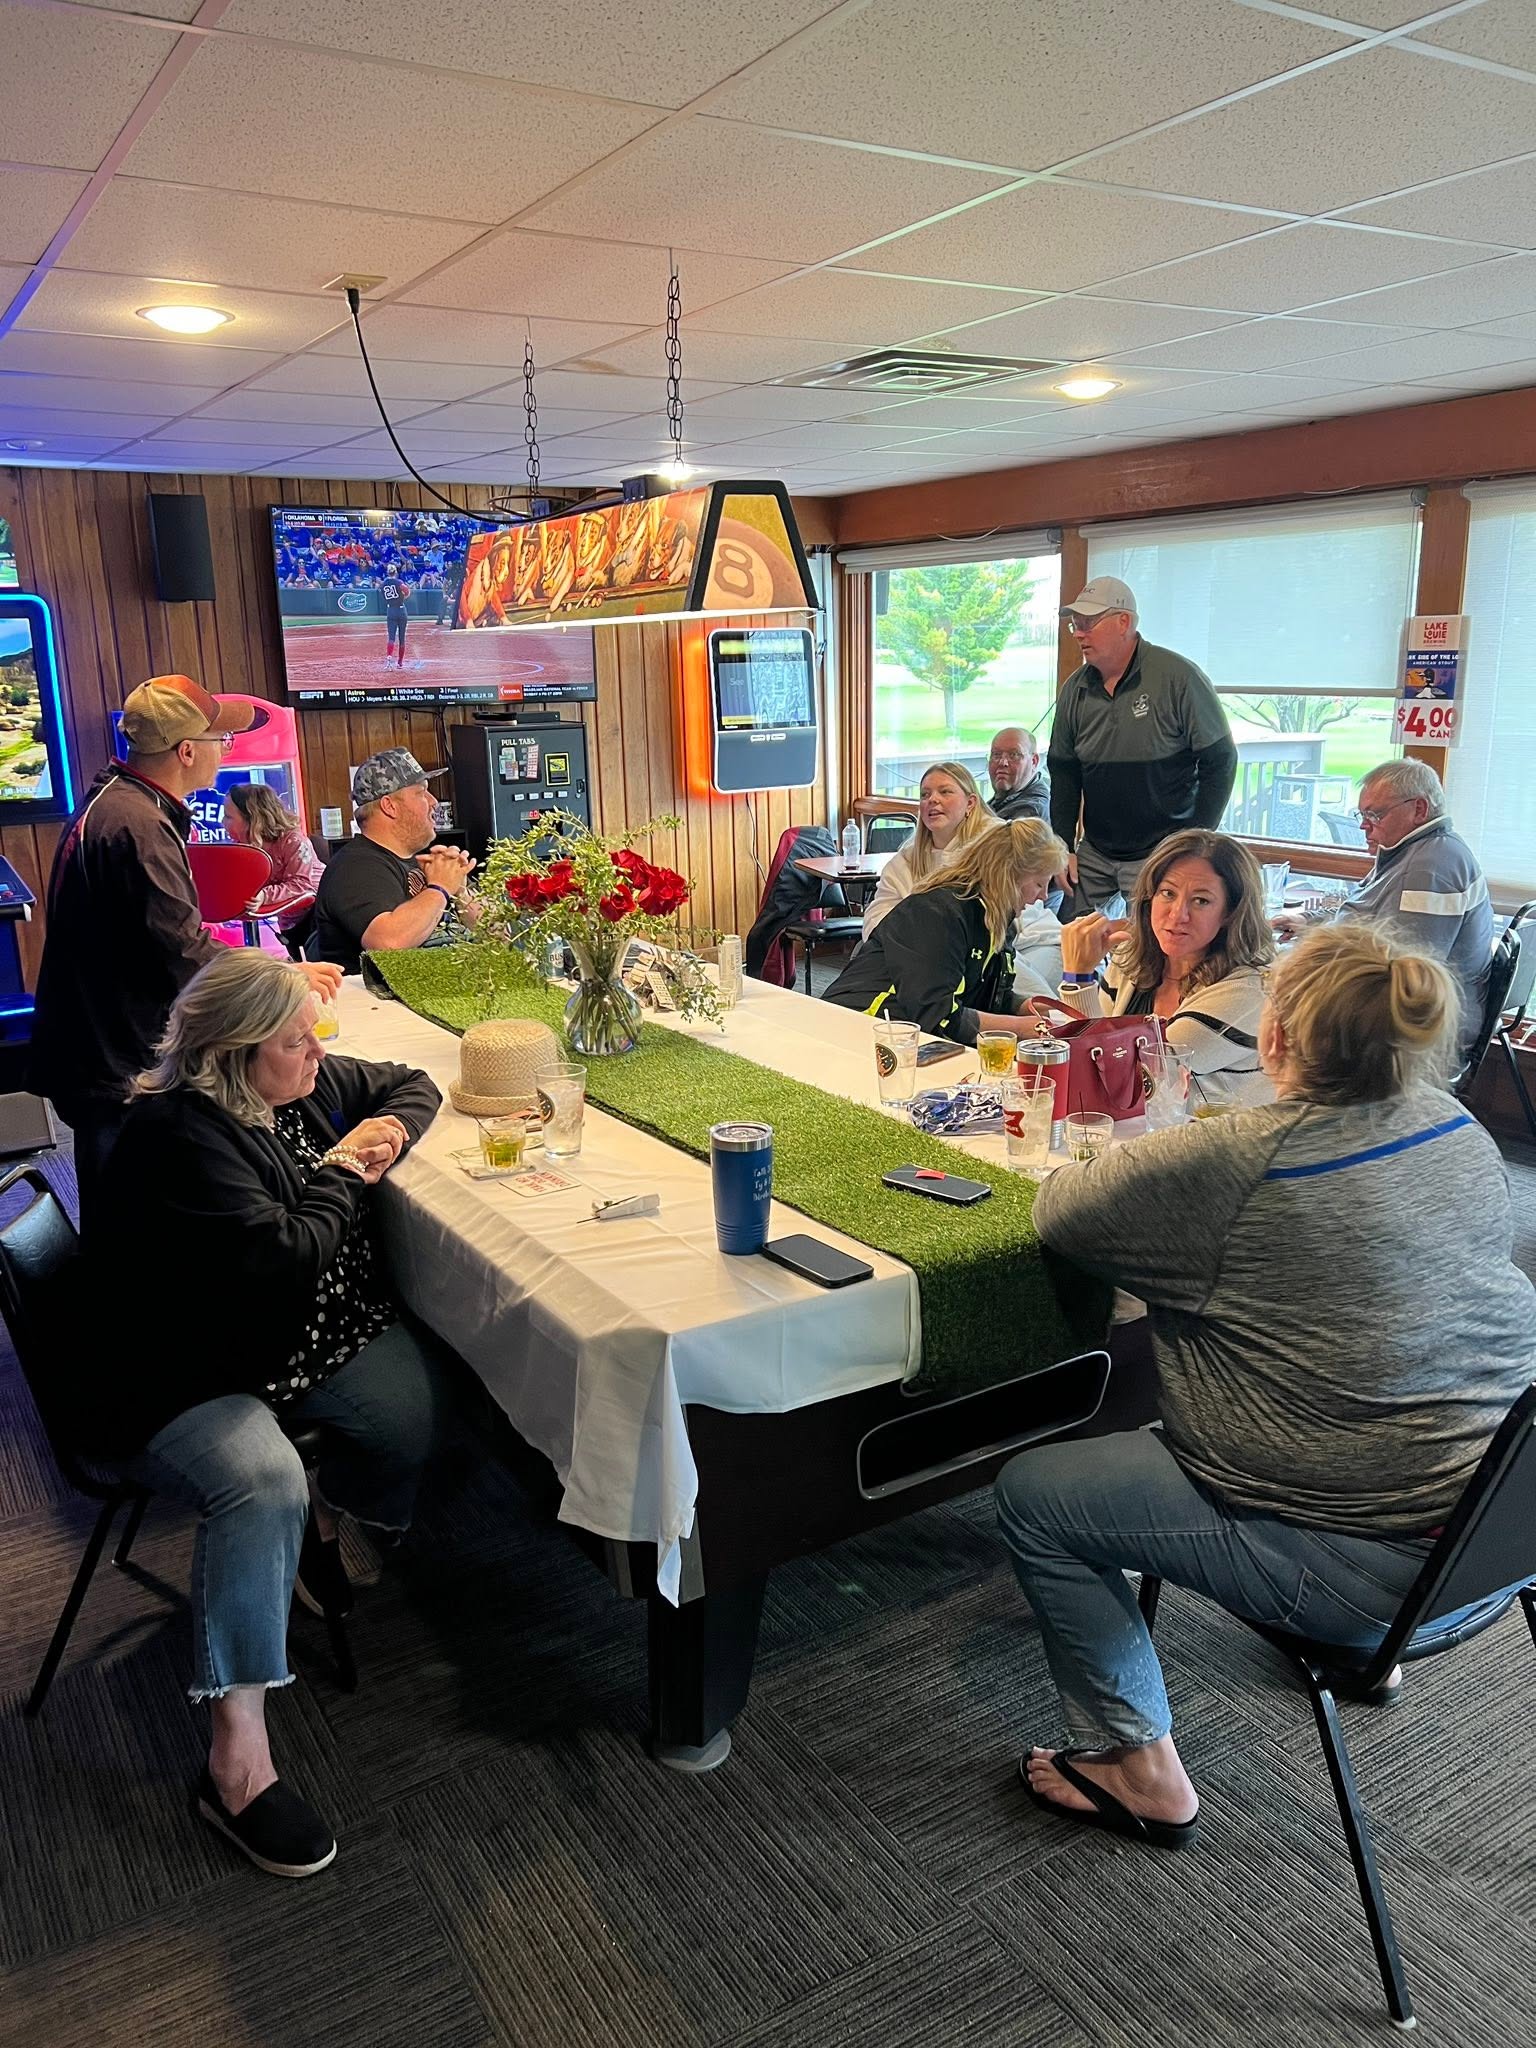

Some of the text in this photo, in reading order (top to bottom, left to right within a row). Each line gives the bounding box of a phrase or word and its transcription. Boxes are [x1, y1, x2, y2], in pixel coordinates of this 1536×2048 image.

[714, 543, 755, 598] 8
[383, 584, 399, 600] 21
[1424, 622, 1448, 630] LAKE
[1423, 630, 1448, 639] LOUIE
[299, 691, 324, 699] ESPN
[501, 737, 536, 746] PULL TABS
